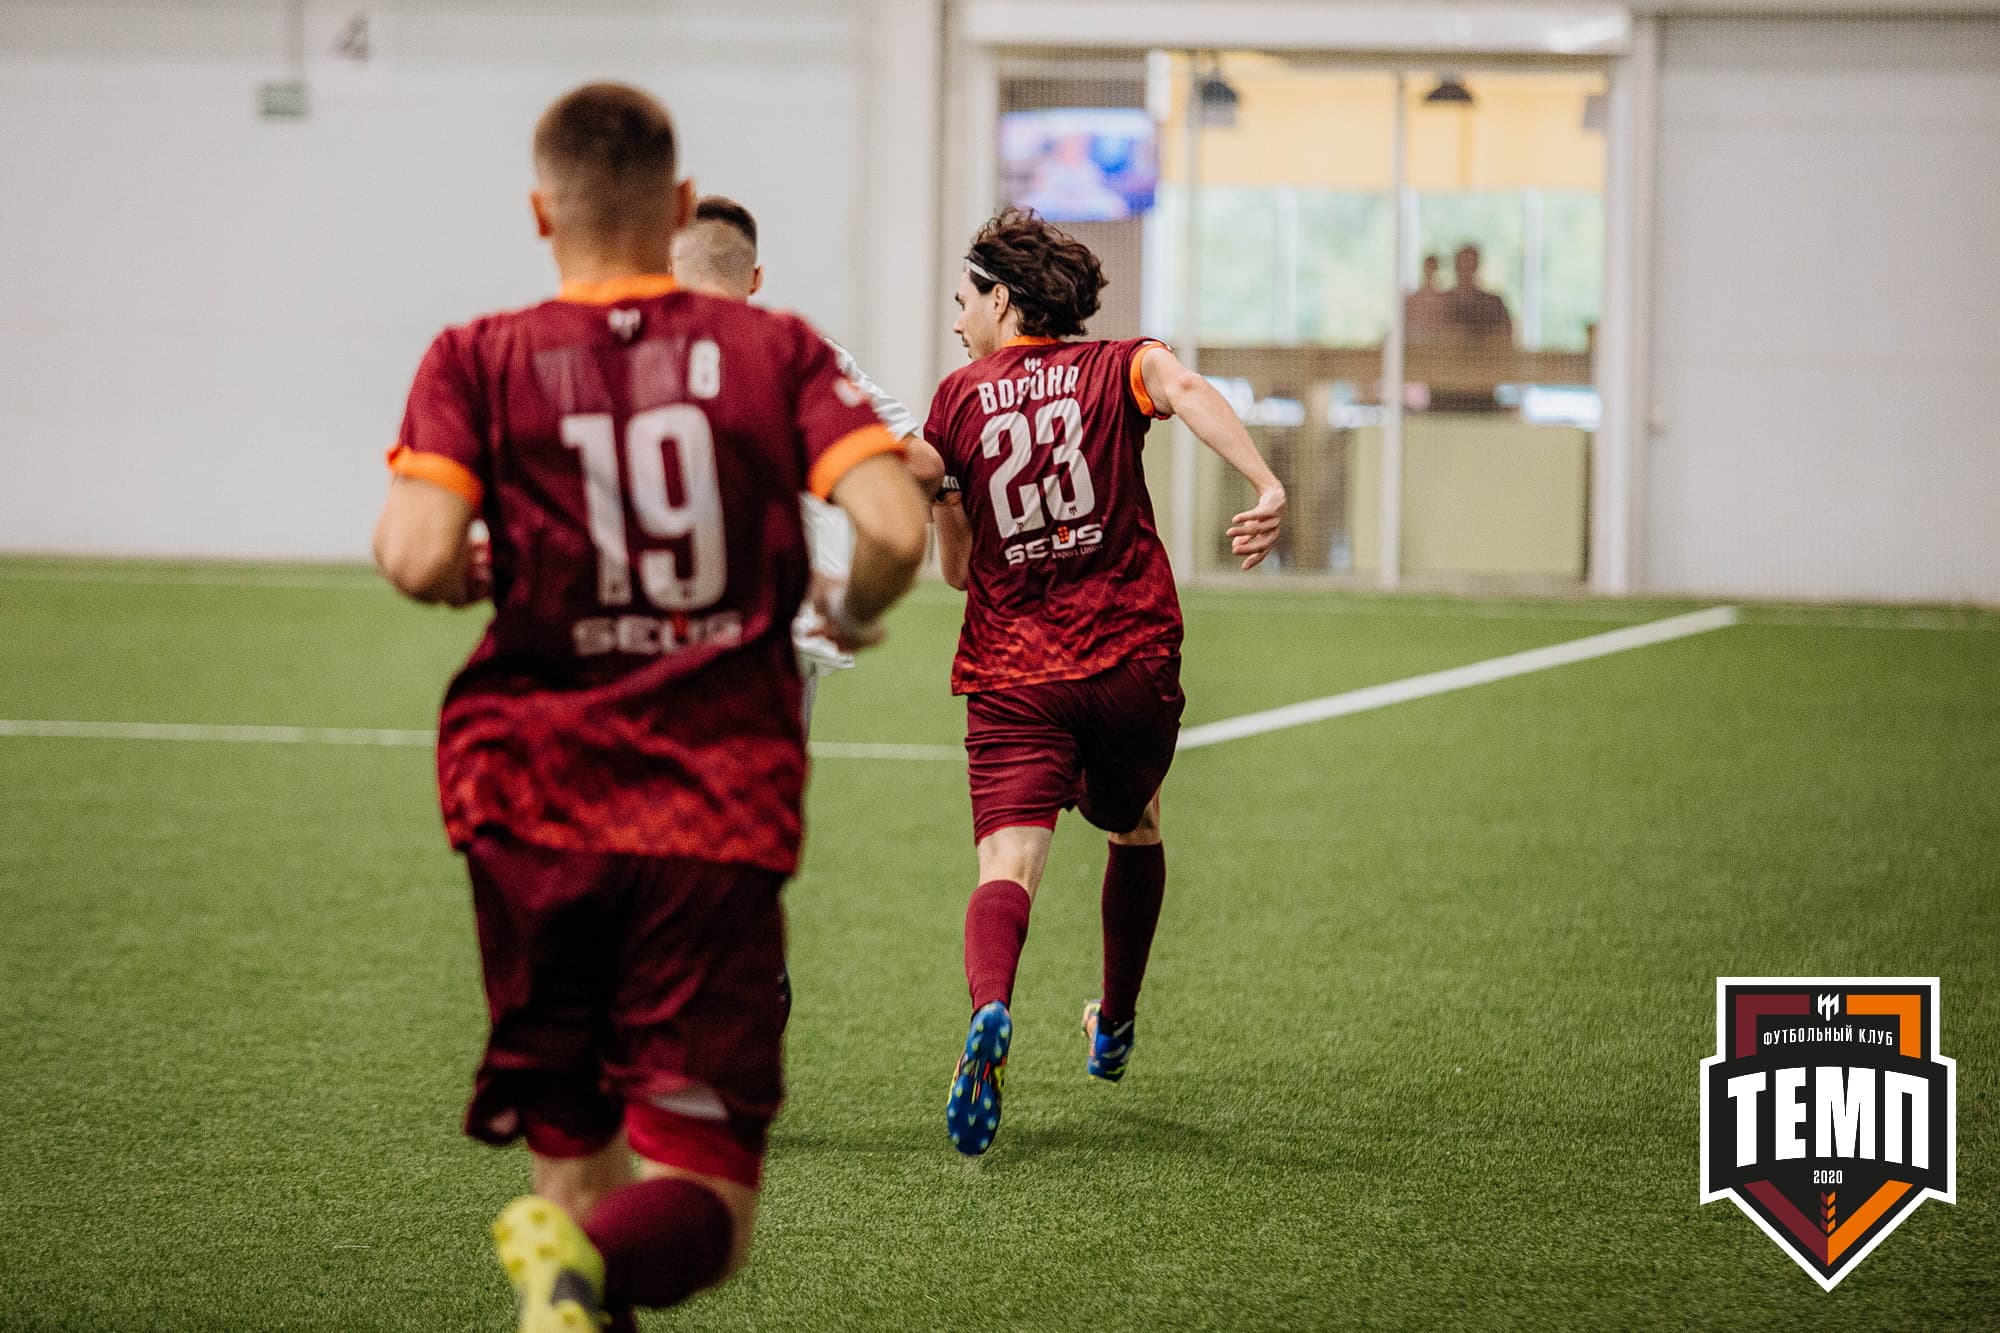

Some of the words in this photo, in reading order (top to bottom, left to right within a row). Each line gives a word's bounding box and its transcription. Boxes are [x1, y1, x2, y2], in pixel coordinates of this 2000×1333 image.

[561, 402, 727, 609] 19
[980, 397, 1096, 538] 23
[1004, 523, 1103, 567] SEUS
